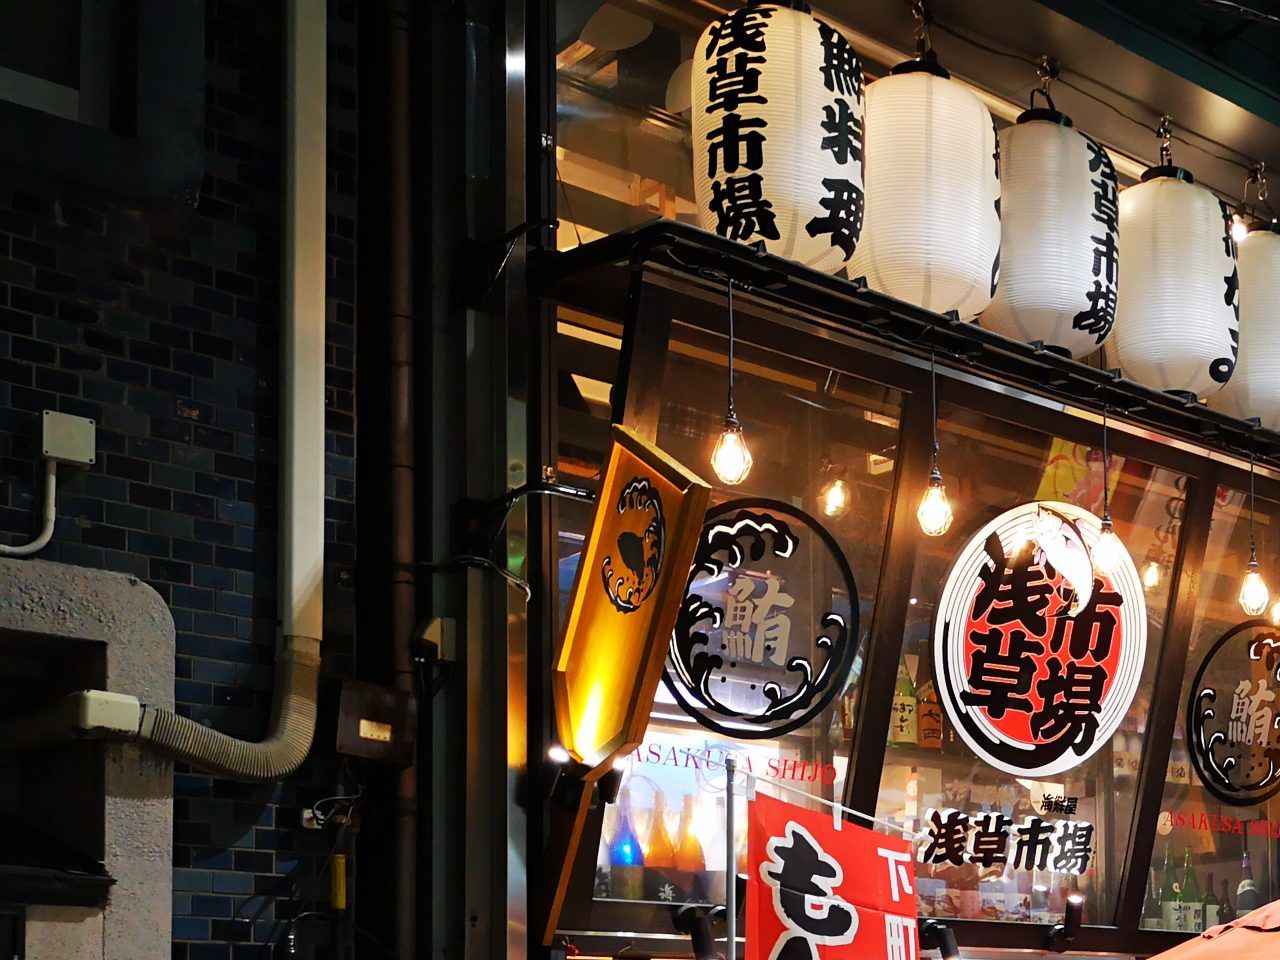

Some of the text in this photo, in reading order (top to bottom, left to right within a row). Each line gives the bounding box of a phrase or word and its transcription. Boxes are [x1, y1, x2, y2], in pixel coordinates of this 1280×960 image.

[703, 5, 781, 243] 浅草市場
[723, 575, 796, 668] 鮪
[1230, 677, 1277, 746] 鮪
[765, 757, 837, 785] SHIJO
[1040, 793, 1079, 815] 海鮮屋
[921, 809, 1095, 875] 浅草市場
[1162, 808, 1242, 835] ASAKUSA
